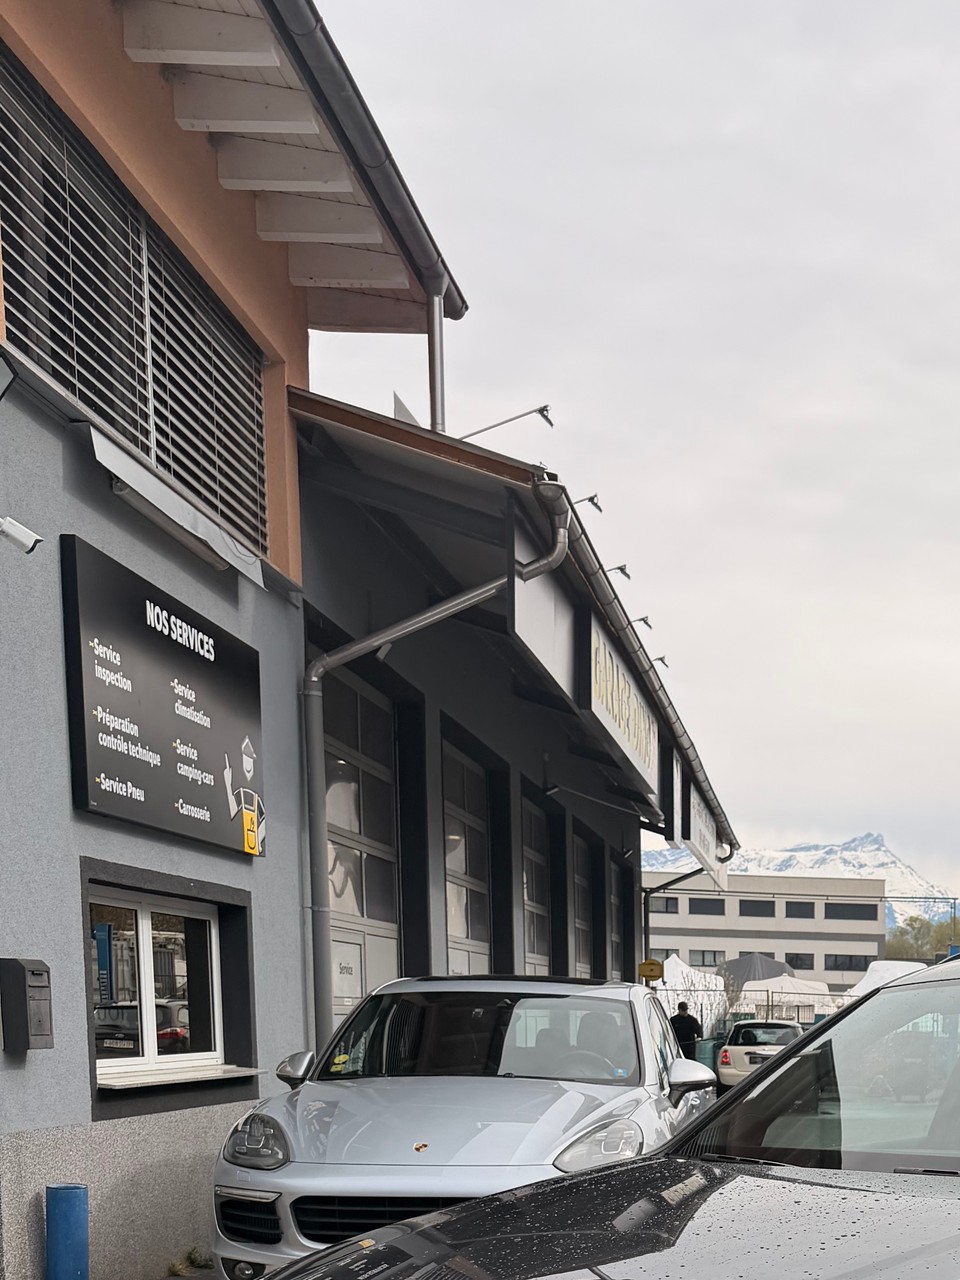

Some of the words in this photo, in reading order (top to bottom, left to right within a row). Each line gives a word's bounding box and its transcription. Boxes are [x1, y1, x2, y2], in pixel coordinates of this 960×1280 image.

[146, 599, 169, 636] NOS
[170, 615, 215, 662] SERVICES
[93, 638, 121, 666] Service
[94, 659, 132, 692] inspection
[174, 678, 196, 702] Service
[97, 705, 139, 738] Préparation
[175, 699, 211, 728] climatisation
[98, 732, 128, 755] contrôle
[128, 740, 161, 767] technique
[176, 738, 198, 761] Service
[100, 772, 127, 796] Service
[127, 781, 145, 801] Pneu
[177, 762, 215, 785] camping-cars
[178, 798, 211, 822] Carrosserie
[339, 962, 353, 975] Service
